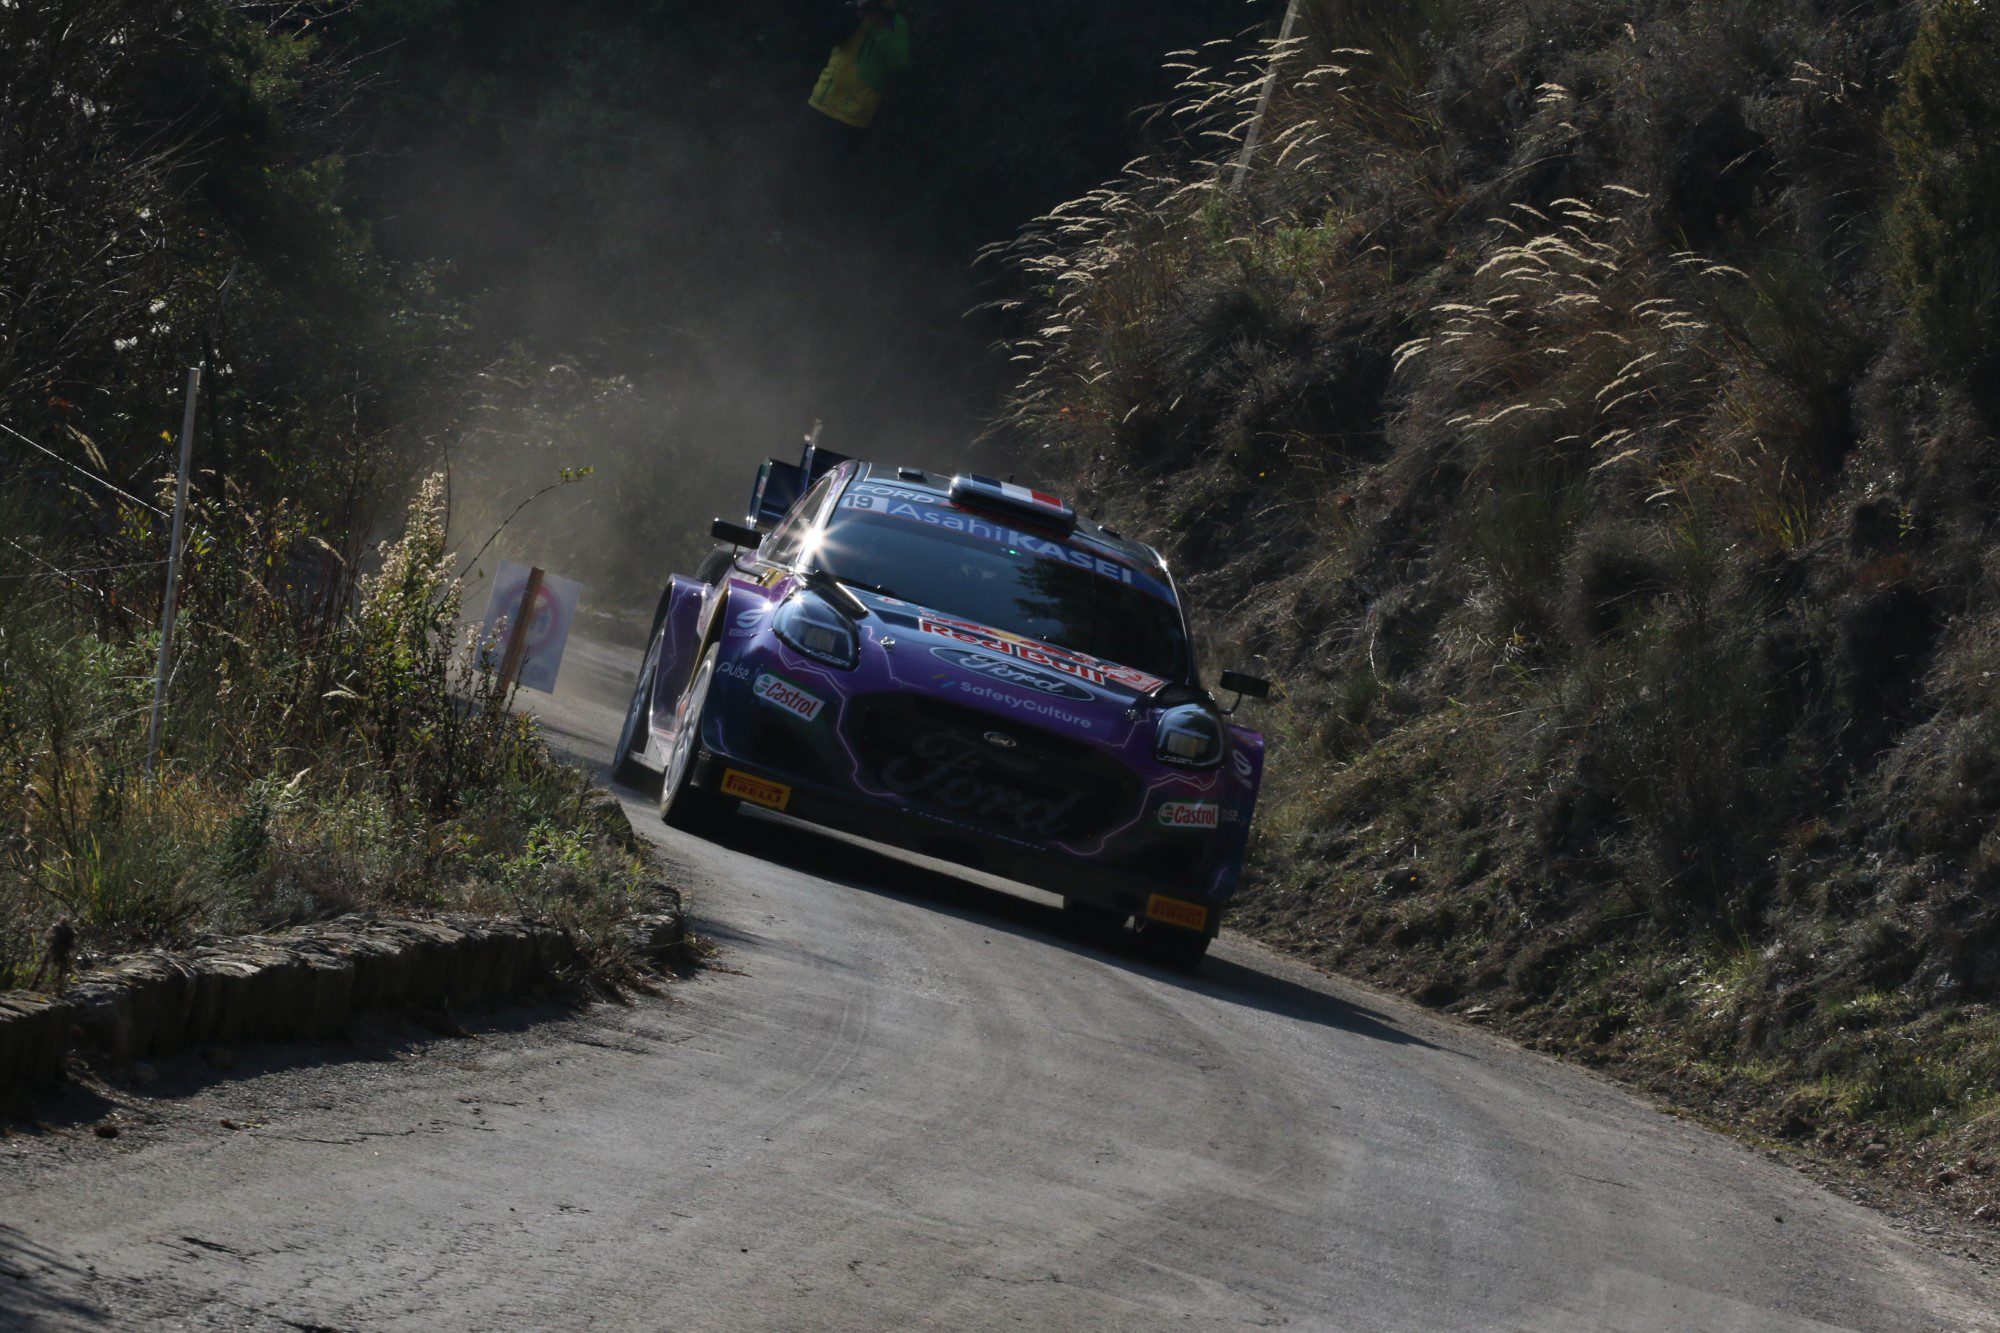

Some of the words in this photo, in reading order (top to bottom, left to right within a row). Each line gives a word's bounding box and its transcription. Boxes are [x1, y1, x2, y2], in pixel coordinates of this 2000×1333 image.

[844, 493, 875, 509] 19
[853, 484, 936, 504] FORD
[918, 617, 1013, 655] Red
[1016, 645, 1106, 686] Bull
[958, 651, 1068, 694] Ford
[766, 682, 818, 718] Castrol
[960, 681, 1093, 729] SafetyCulture
[725, 773, 784, 805] PIRELLI
[881, 731, 1086, 833] Ford
[1174, 805, 1216, 825] Castrol
